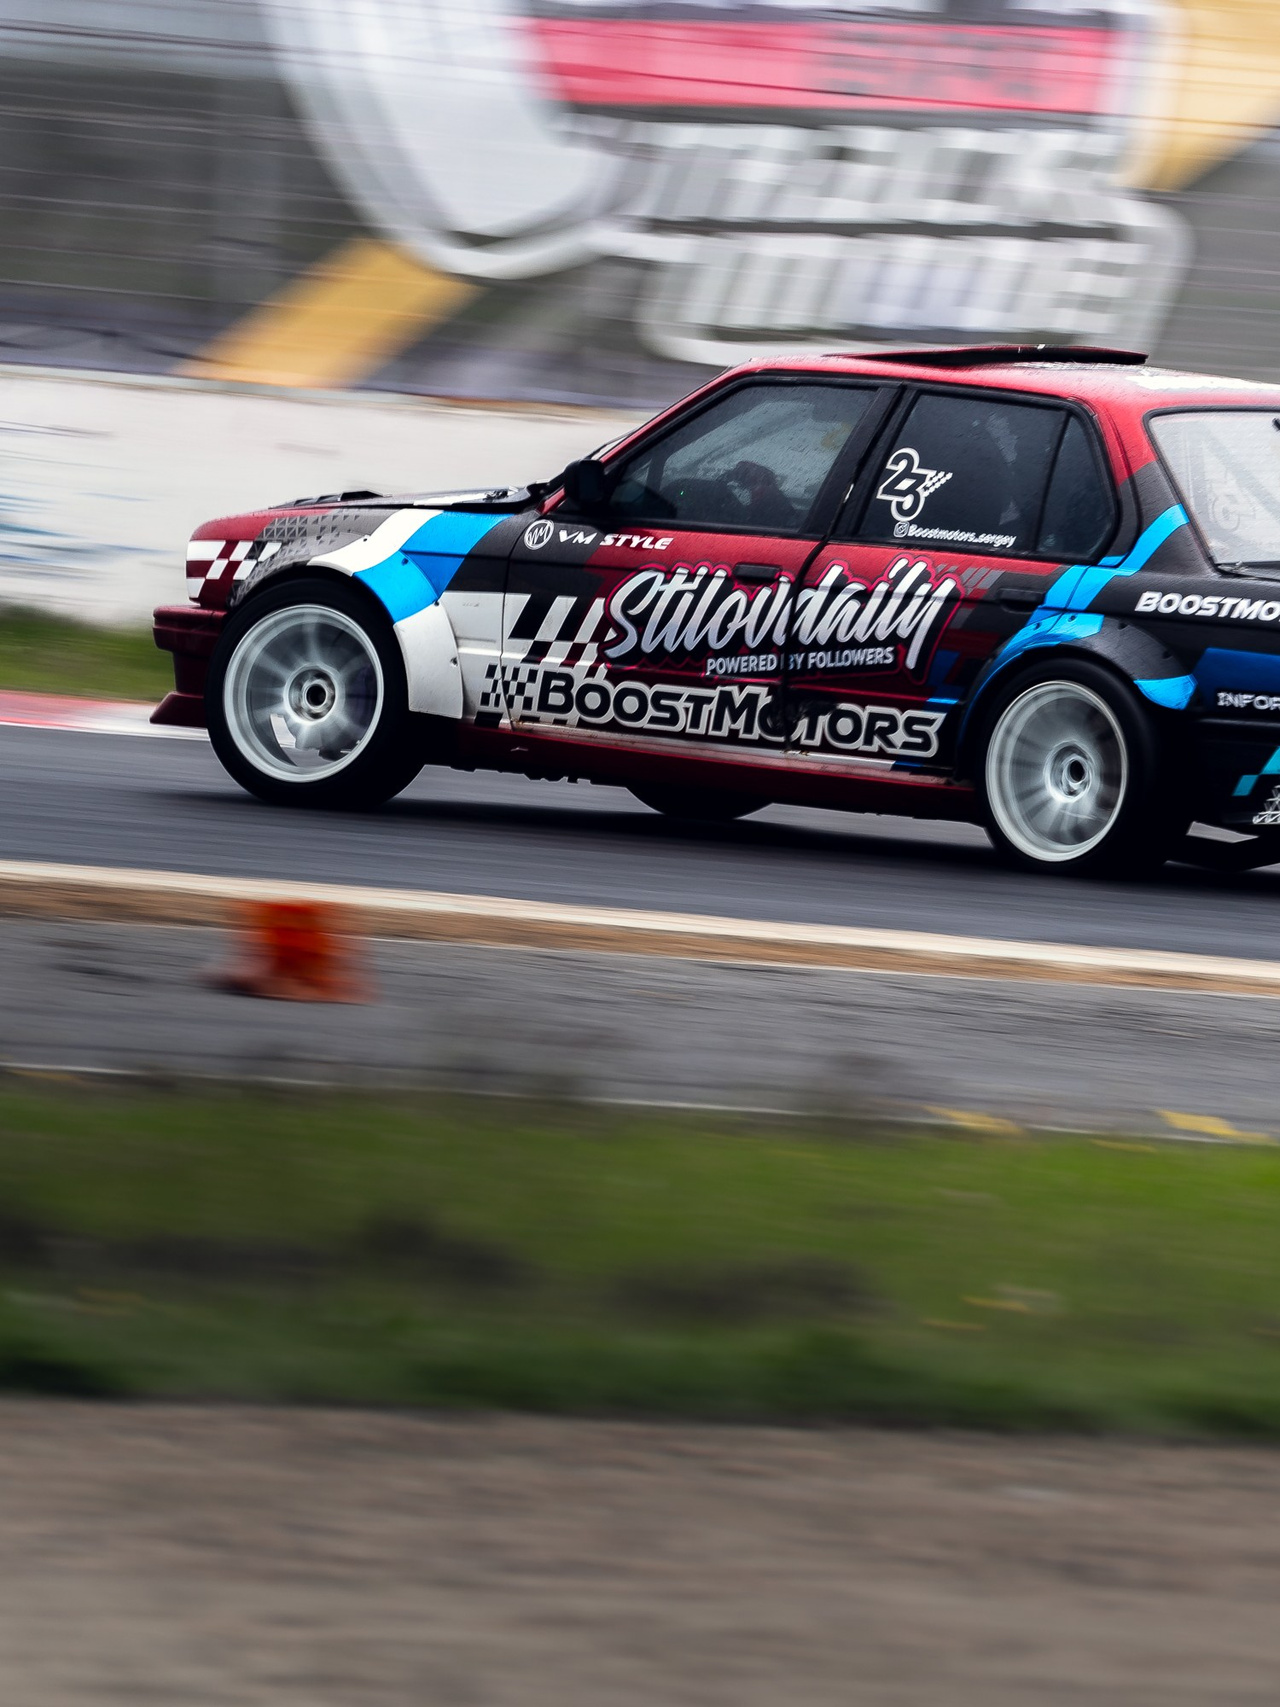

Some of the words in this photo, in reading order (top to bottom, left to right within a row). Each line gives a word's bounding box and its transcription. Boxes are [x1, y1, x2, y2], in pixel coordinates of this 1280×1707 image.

[876, 447, 947, 522] 23
[558, 529, 598, 545] VM
[599, 533, 674, 550] STYLE
[705, 653, 777, 676] POWERED
[807, 646, 896, 669] FOLLOWERS
